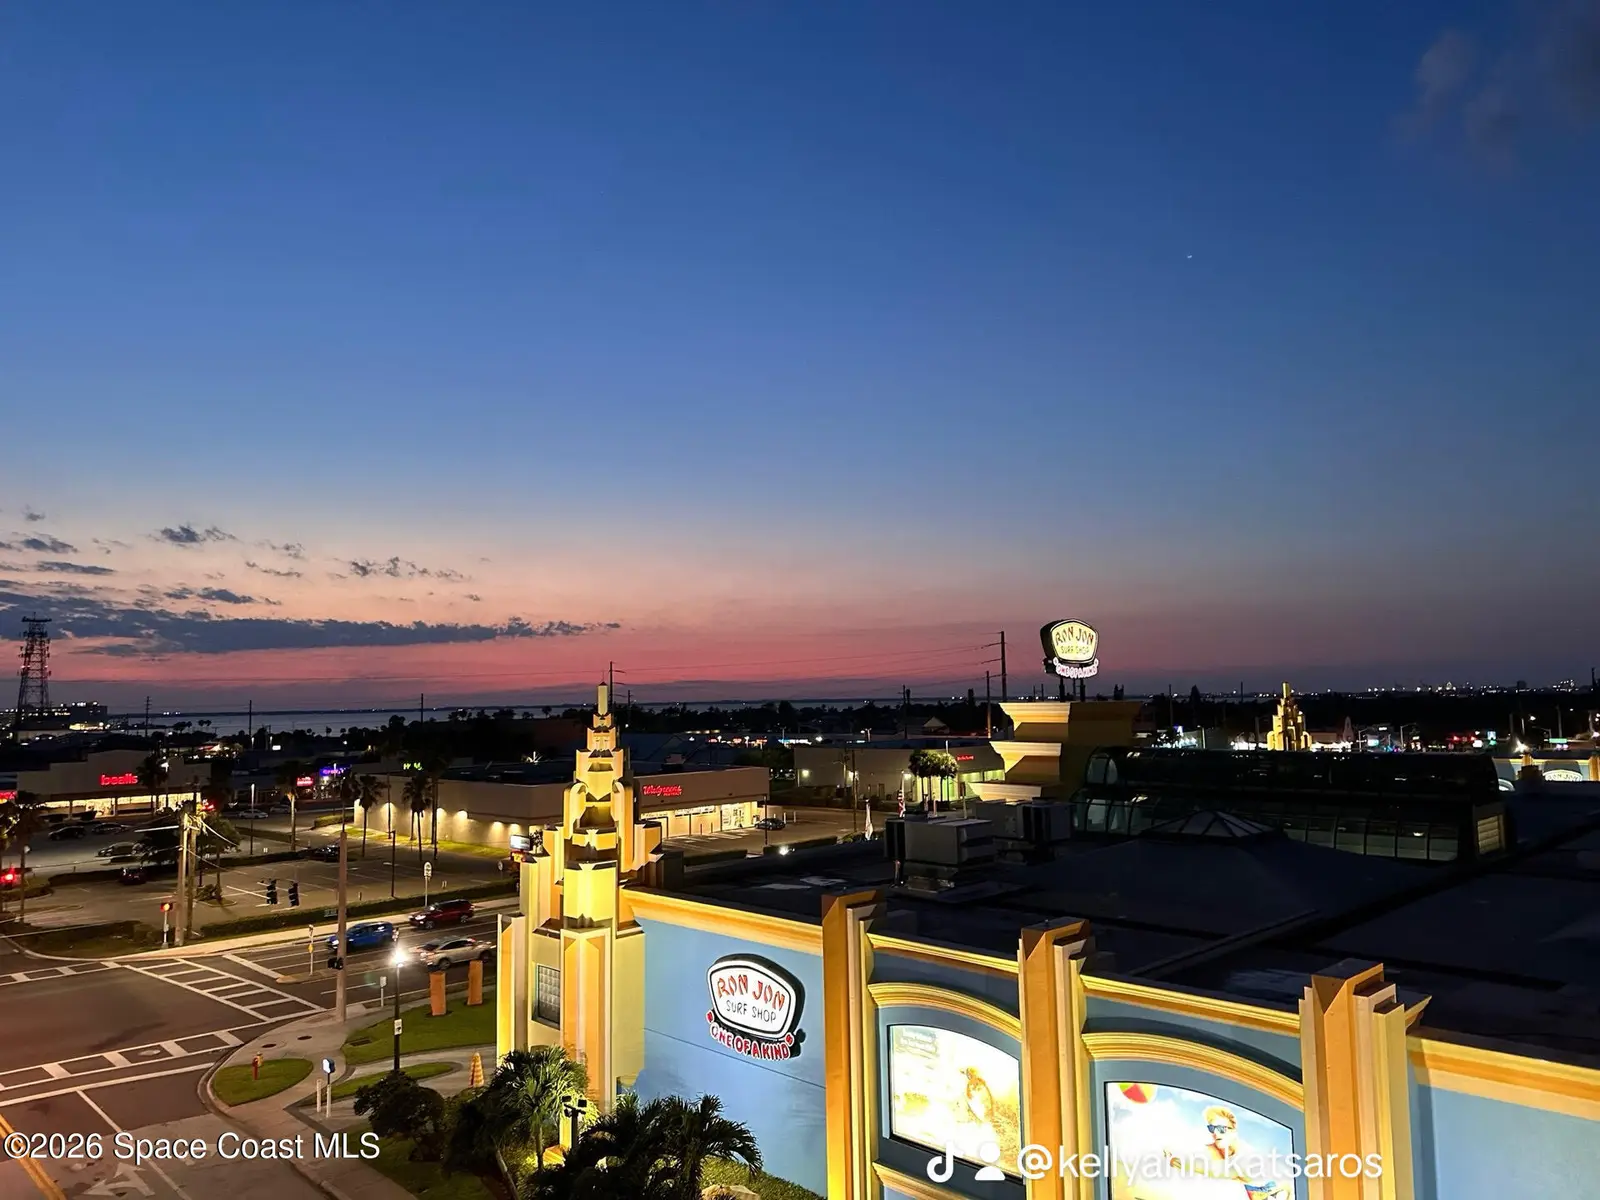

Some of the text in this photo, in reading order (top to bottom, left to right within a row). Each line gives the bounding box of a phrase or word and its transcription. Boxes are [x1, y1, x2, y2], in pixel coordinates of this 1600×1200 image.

[1055, 626, 1094, 646] RON JON
[101, 773, 138, 786] bealls
[717, 974, 786, 1012] RON JON
[725, 999, 777, 1024] SURF SHOP
[710, 1023, 791, 1060] ONE OF A KIND
